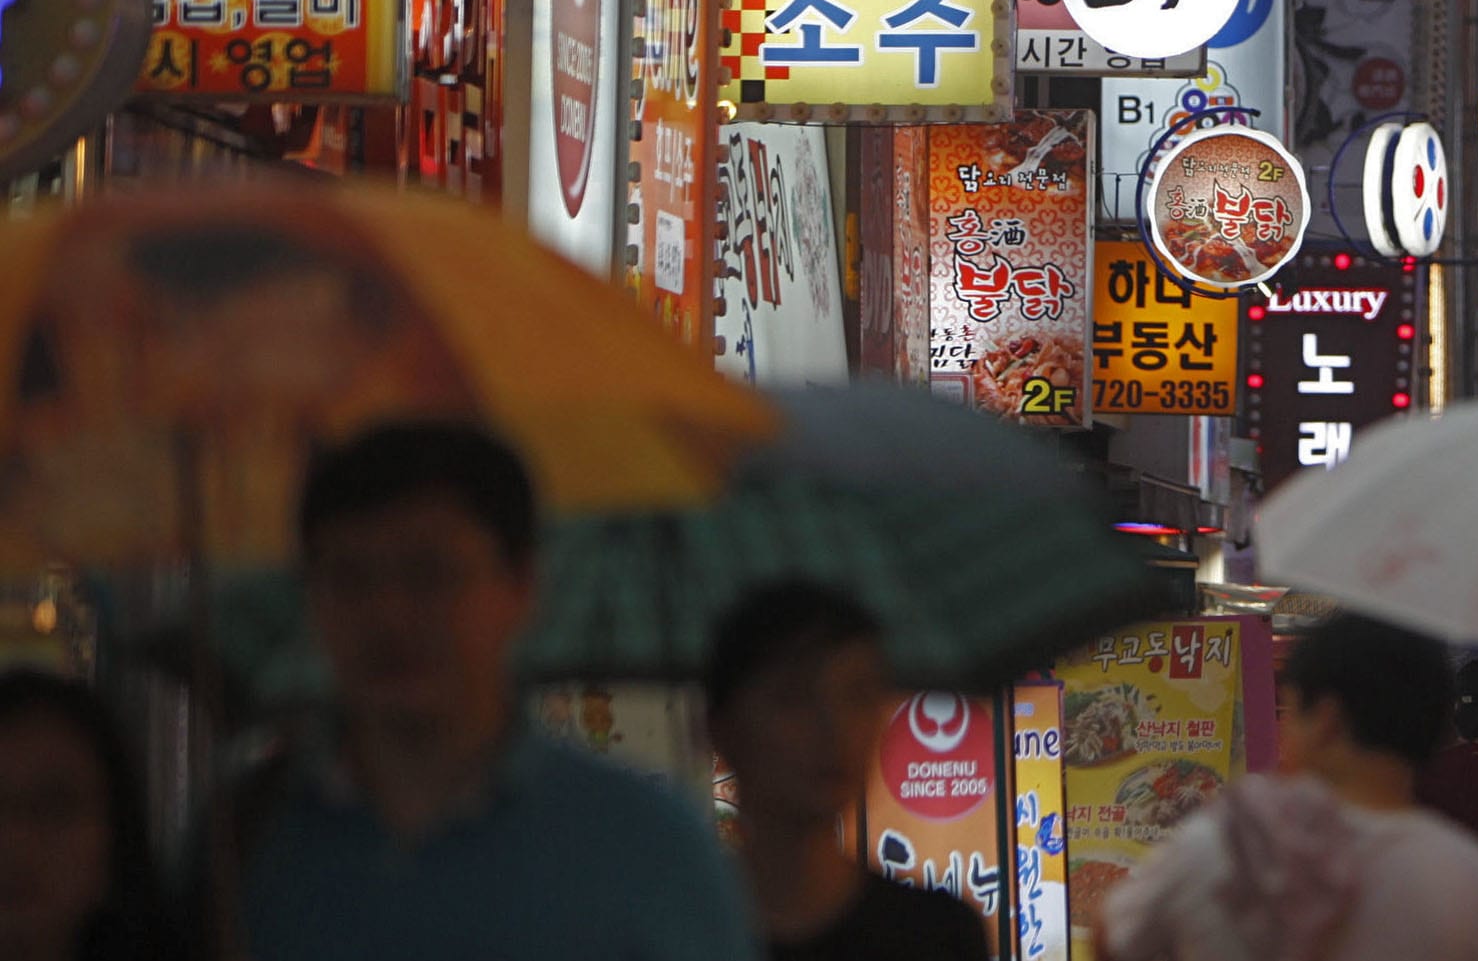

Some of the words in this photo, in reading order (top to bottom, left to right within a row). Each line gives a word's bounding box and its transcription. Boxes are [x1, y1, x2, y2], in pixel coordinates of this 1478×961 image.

[225, 38, 334, 91] 영업
[1118, 95, 1156, 125] B1
[1258, 161, 1285, 182] 2F
[953, 253, 1076, 322] 불닭
[1266, 288, 1388, 321] Luxury
[1093, 322, 1218, 371] 부동산
[1022, 378, 1075, 414] 2F
[1094, 379, 1230, 409] 720-3335
[907, 762, 977, 779] DONENU
[901, 782, 945, 798] SINCE
